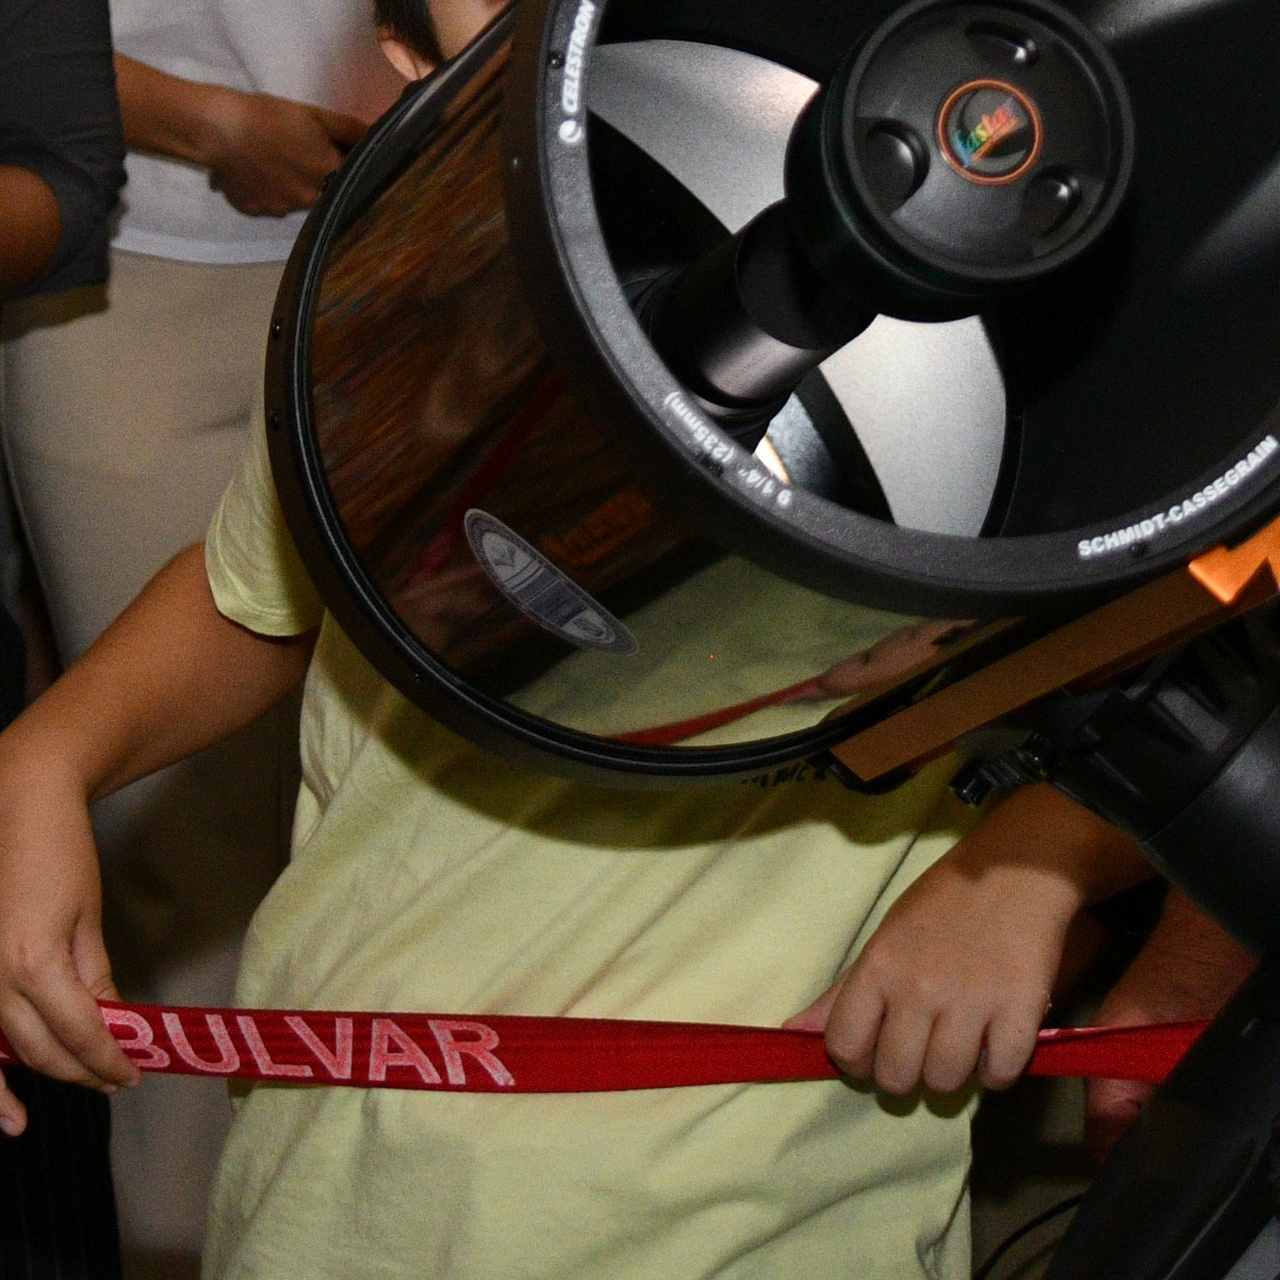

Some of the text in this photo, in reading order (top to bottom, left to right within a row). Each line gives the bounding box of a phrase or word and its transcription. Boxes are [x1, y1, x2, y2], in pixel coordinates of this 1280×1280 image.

[664, 391, 735, 464] (235mm)
[776, 487, 792, 509] 9
[1077, 434, 1280, 558] SCHMIDT-CASSEGRAIN
[101, 1006, 516, 1087] BULVAR
